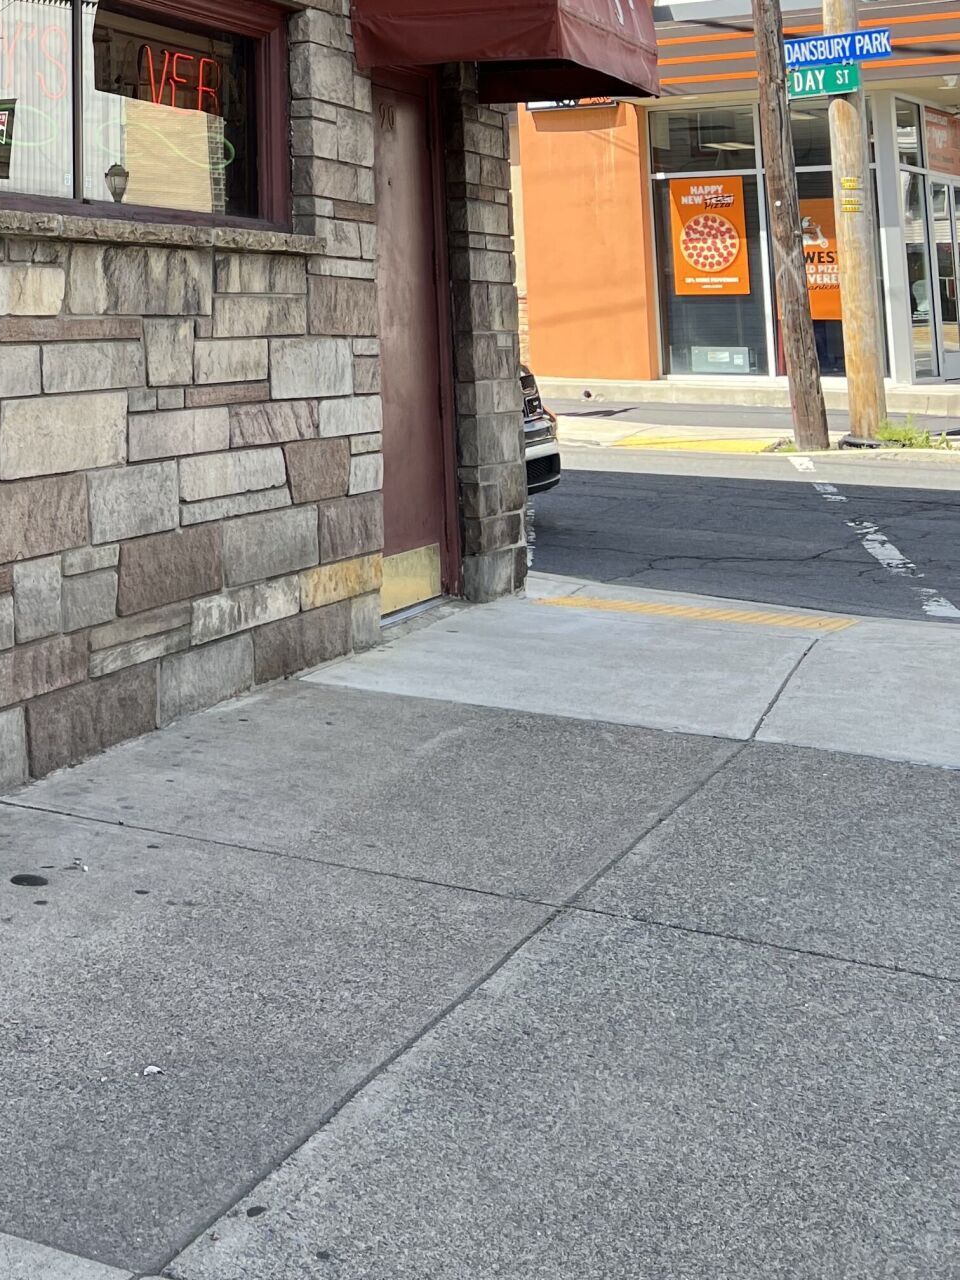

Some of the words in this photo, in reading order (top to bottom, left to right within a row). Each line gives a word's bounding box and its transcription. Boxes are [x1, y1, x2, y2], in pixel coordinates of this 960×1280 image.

[784, 36, 852, 64] DANSBURY
[855, 31, 892, 55] PARK
[793, 70, 825, 92] DAY
[836, 70, 849, 84] ST
[690, 185, 724, 195] HAPPY
[681, 195, 703, 205] NEW
